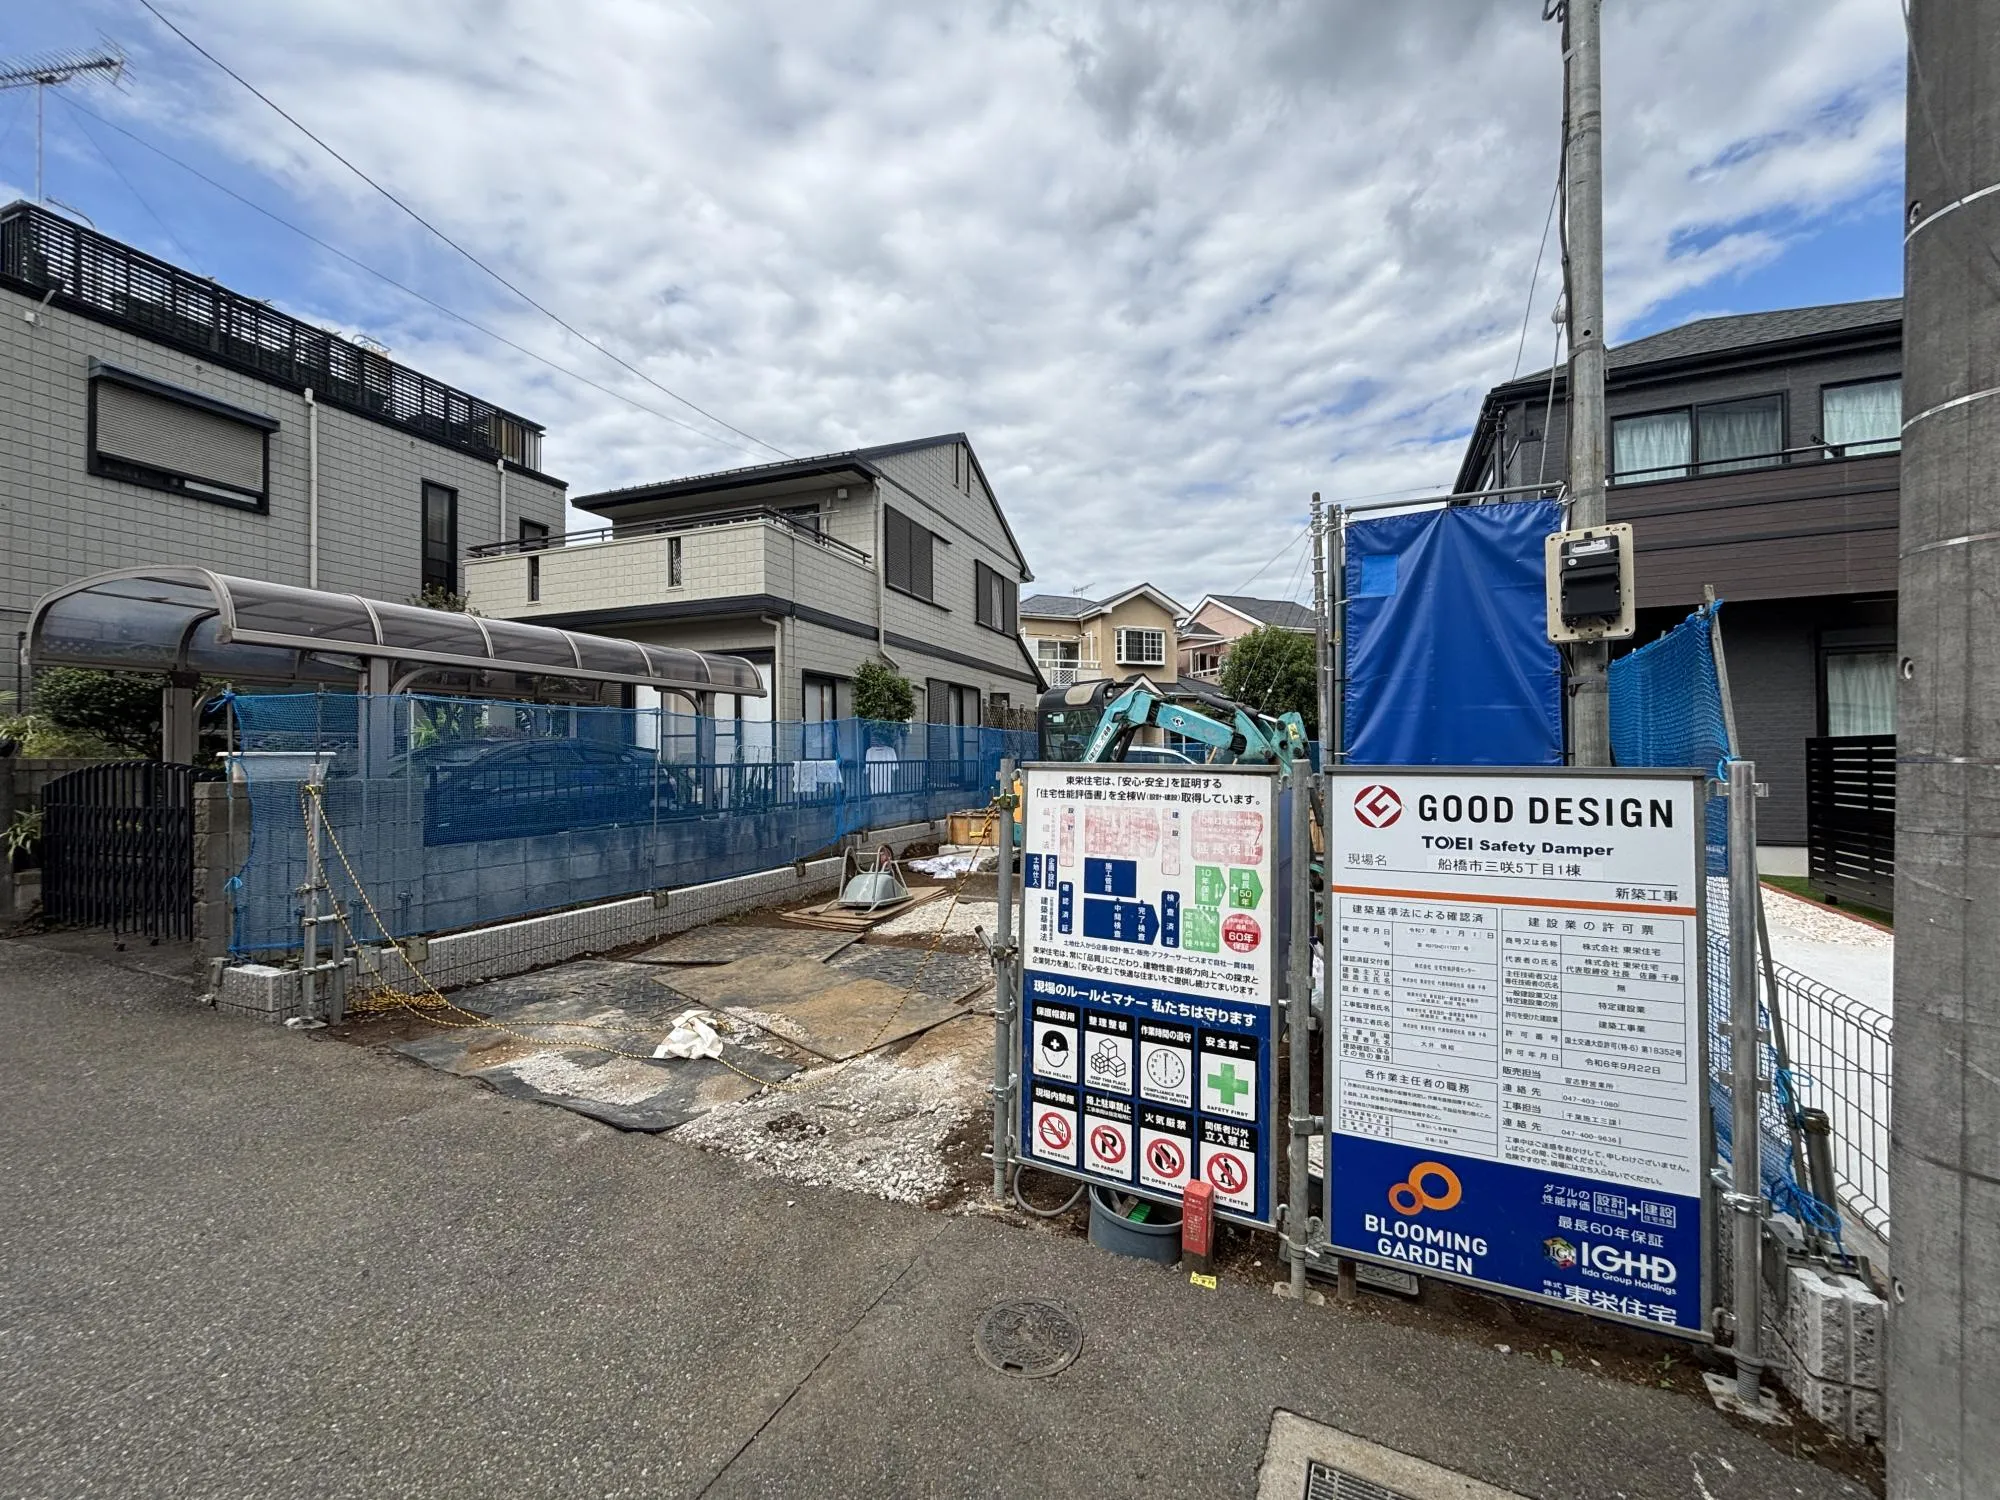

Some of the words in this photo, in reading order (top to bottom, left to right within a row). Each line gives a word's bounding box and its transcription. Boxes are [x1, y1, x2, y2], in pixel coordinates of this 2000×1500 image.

[1066, 776, 1222, 788] 東栄住宅は、「安心・安全」を証明する
[1418, 795, 1514, 824] GOOD
[1529, 797, 1673, 828] DESIGN
[1480, 840, 1536, 855] Safety
[1542, 842, 1614, 857] Damper
[1348, 853, 1387, 866] 現場名
[1438, 858, 1582, 877] 船橋市三咲5丁目1棟
[1615, 887, 1678, 902] 新築工事
[1061, 884, 1069, 932] 確認済証
[1352, 904, 1483, 923] 建築基準法による確認済
[1166, 894, 1174, 946] 検査済証
[1528, 917, 1654, 935] 建設業の許可票
[1229, 932, 1254, 943] 60年
[1343, 925, 1390, 936] 確認年月日
[1505, 936, 1558, 948] 商号又は名称
[1582, 943, 1618, 953] 株式会社
[1623, 946, 1661, 956] 東栄住宅
[1343, 955, 1390, 966] 確認済証交付者
[1505, 956, 1558, 967] 代表者の氏名
[1585, 958, 1619, 968] 株式会社
[1623, 962, 1659, 972] 東栄住宅
[1506, 970, 1558, 981] 主任技術者又は
[1566, 966, 1608, 977] 代表取締役
[1612, 970, 1630, 979] 社長
[1505, 978, 1559, 989] 専任技術者の氏名
[1506, 990, 1558, 1000] 一般建設業又は
[1034, 980, 1148, 1006] 現場のルールとマナー
[1152, 998, 1256, 1027] 私たちは守ります
[1343, 1001, 1390, 1012] 工事監理者氏名
[1506, 998, 1558, 1008] 特定建設業の別
[1598, 1002, 1646, 1013] 特定建設業
[1036, 1006, 1075, 1022] 保護帽着用
[1505, 1011, 1558, 1023] 許可を受けた建設業
[1088, 1015, 1128, 1032] 整理整頓
[1599, 1021, 1646, 1033] 建築工事業
[1141, 1025, 1192, 1043] 作業時間の遵守
[1505, 1030, 1558, 1042] 許可番号
[1205, 1036, 1250, 1051] 安全第一
[1343, 1050, 1389, 1061] その他の事項
[1505, 1048, 1558, 1061] 許可年月日
[1641, 1045, 1682, 1058] 第18352号
[1502, 1066, 1541, 1079] 販売担当
[1585, 1058, 1660, 1074] 令和6年9月22日
[1365, 1069, 1470, 1093] 各作業主任者の職務
[1502, 1083, 1541, 1097] 連絡先
[1086, 1095, 1132, 1114] 路上駐車禁止
[1207, 1105, 1229, 1114] SAFETY
[1502, 1101, 1541, 1114] 工事担当
[1145, 1112, 1186, 1131] 火気厳禁
[1502, 1118, 1542, 1132] 連絡先
[1205, 1121, 1250, 1139] 関係者以外
[1205, 1131, 1250, 1150] 立入禁止
[1544, 1184, 1590, 1200] ダブルの
[1542, 1194, 1591, 1212] 性能評価
[1597, 1195, 1624, 1209] 設計
[1644, 1204, 1673, 1219] 建設
[1365, 1214, 1488, 1256] BLOOMING
[1558, 1215, 1664, 1248] 最長60年保証
[1378, 1238, 1473, 1275] GARDEN
[1582, 1242, 1677, 1284] IGHD
[1602, 1272, 1632, 1286] Group
[1634, 1279, 1677, 1296] Holdings
[1564, 1283, 1677, 1326] 東栄住宅
